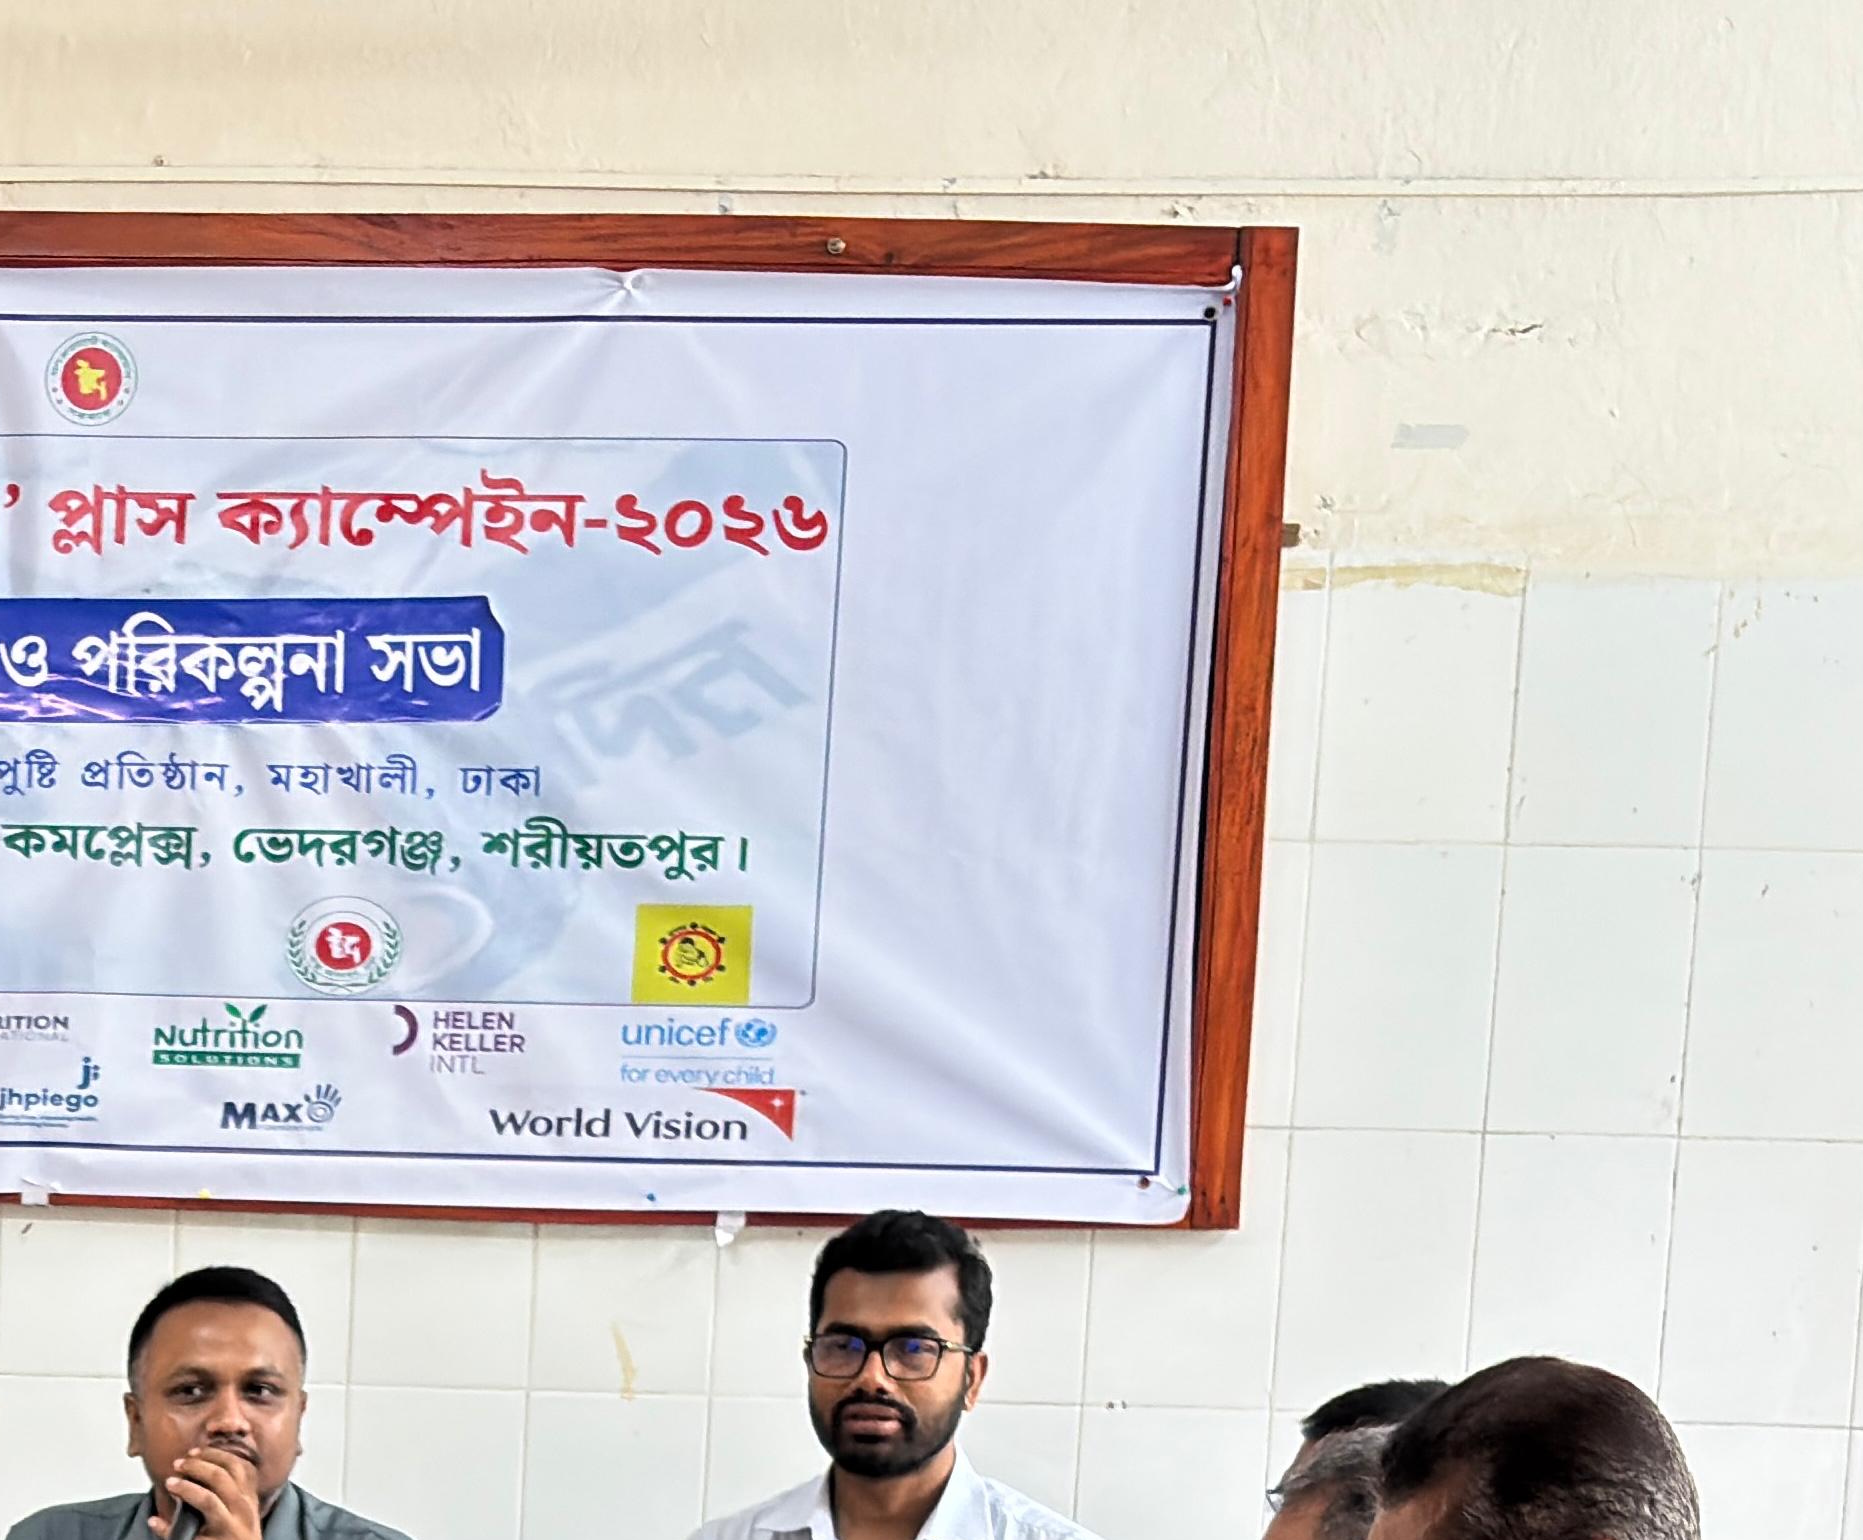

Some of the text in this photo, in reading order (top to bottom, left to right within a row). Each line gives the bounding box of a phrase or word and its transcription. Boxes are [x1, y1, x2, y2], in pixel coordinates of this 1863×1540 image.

[48, 483, 196, 555] প্লাস
[216, 468, 829, 556] ক্যাম্পেইন-২০২৬
[72, 611, 346, 712] পরিকল্পনা
[369, 628, 482, 693] সভা
[462, 764, 542, 798] ঢাকা
[2, 821, 211, 871] কমপ্লেক্স,
[232, 827, 461, 877] ভেদরগঞ্জ,
[154, 1016, 304, 1049] Nutrition
[433, 1010, 515, 1031] HELEN
[621, 1017, 733, 1047] unicef
[432, 1033, 526, 1054] KELLER
[158, 1052, 295, 1067] SOLUTIONS
[429, 1055, 486, 1076] INTL
[620, 1063, 775, 1085] for every child
[220, 1101, 304, 1130] MAX
[488, 1107, 748, 1141] World Vision
